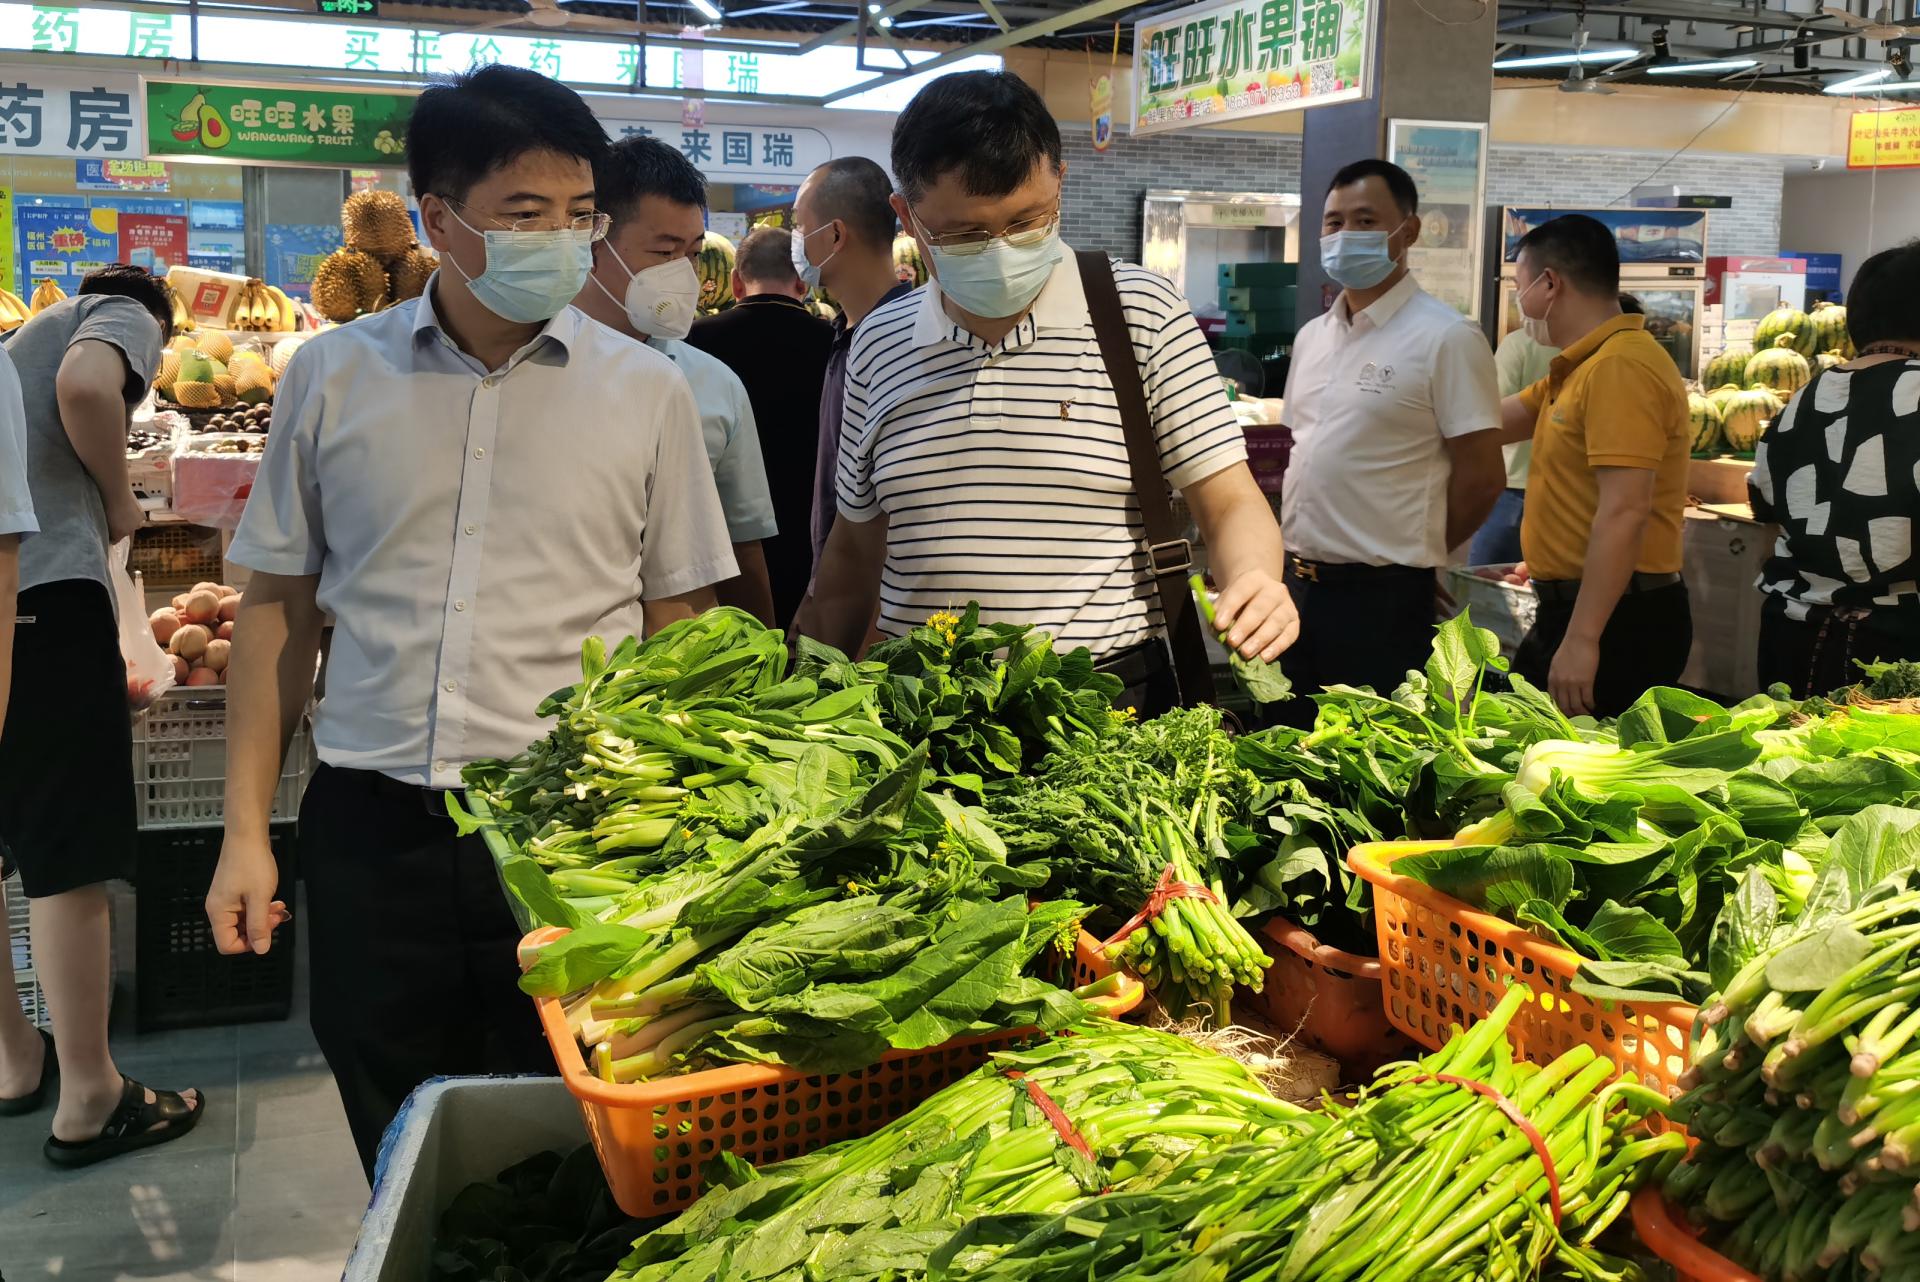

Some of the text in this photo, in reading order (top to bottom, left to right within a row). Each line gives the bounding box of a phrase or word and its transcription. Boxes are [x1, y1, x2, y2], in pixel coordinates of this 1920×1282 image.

[31, 4, 176, 58] 药房
[0, 82, 133, 152] 药房
[230, 99, 355, 135] 旺旺水果
[238, 131, 354, 146] WANGWANG FRUIT
